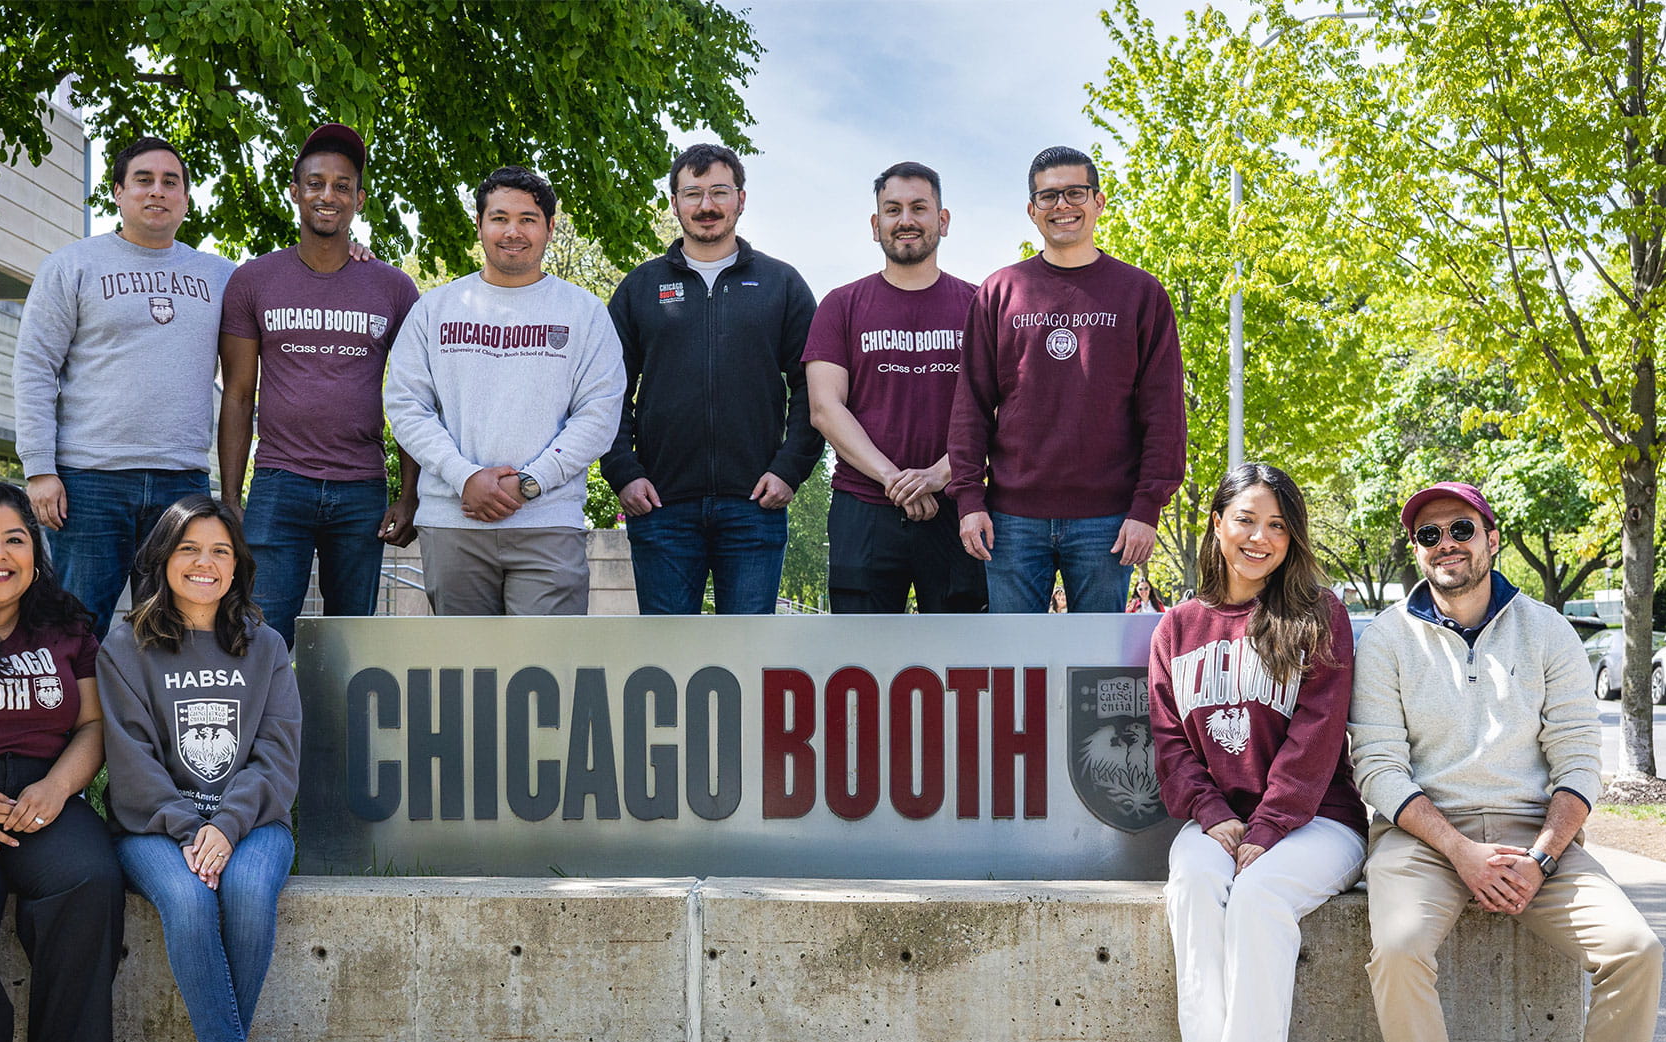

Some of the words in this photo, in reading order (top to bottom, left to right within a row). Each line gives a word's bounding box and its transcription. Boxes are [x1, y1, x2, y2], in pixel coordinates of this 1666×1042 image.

[100, 271, 211, 303] UCHICAGO
[264, 308, 322, 332] CHICAGO
[324, 310, 368, 334] BOOTH
[1012, 312, 1070, 329] CHICAGO
[1072, 311, 1118, 328] BOOTH
[440, 321, 502, 349] CHICAGO
[502, 324, 548, 349] BOOTH
[860, 329, 914, 353] CHICAGO
[915, 329, 955, 352] BOOTH
[280, 342, 317, 354] Class
[320, 343, 335, 354] of
[337, 344, 368, 357] 2025
[877, 362, 911, 374] Class
[913, 362, 927, 374] of
[929, 363, 960, 373] 2026
[164, 669, 246, 690] HABSA
[346, 665, 742, 822] CHICAGO
[761, 665, 1047, 821] BOOTH
